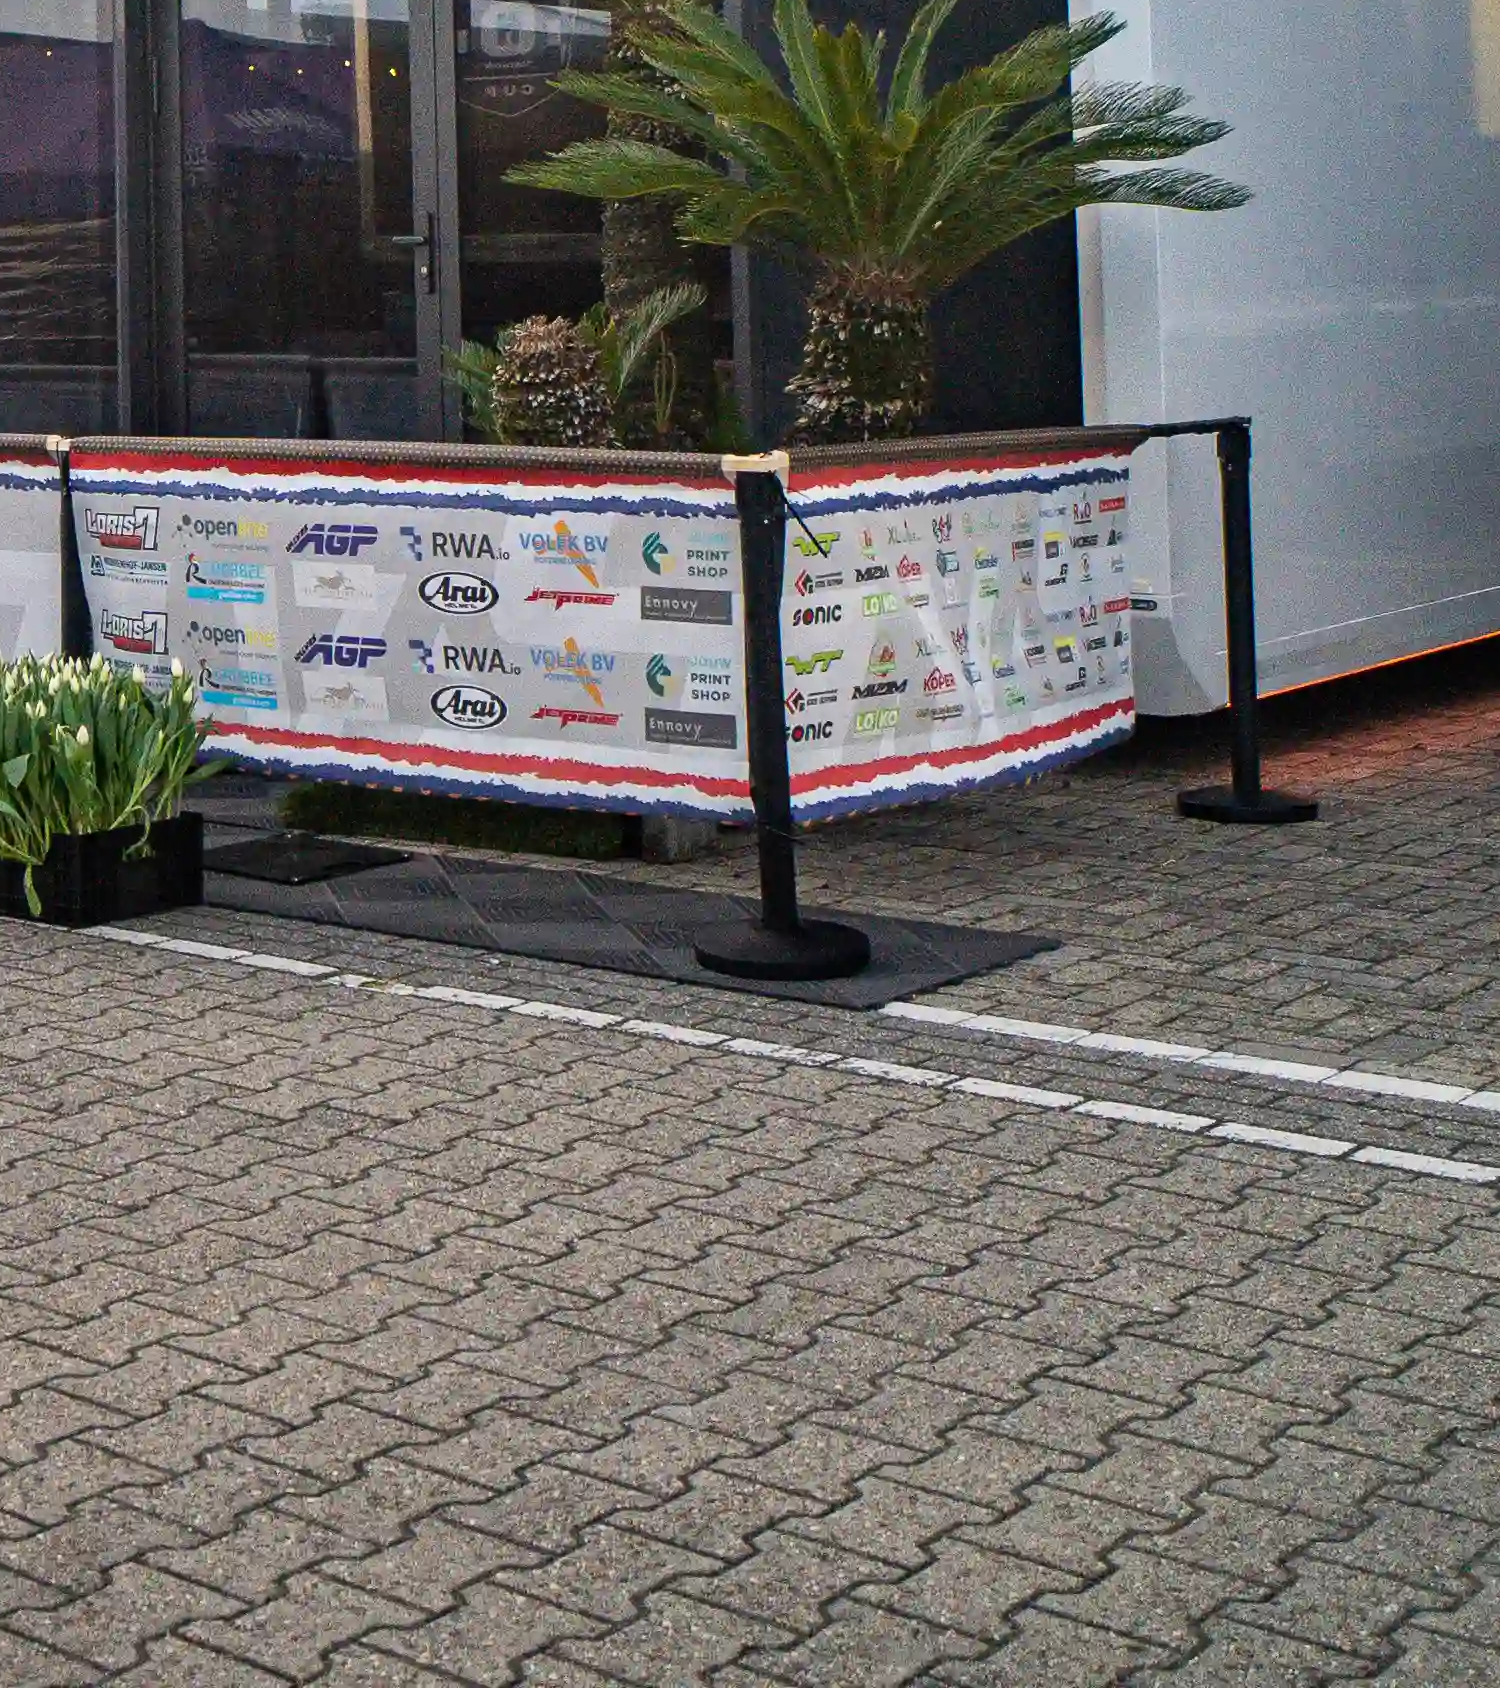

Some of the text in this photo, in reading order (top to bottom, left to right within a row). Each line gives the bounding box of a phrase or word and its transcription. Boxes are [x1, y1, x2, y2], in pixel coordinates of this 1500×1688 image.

[291, 522, 379, 557] AGP
[431, 531, 510, 561] RWA.io
[686, 549, 731, 562] PRINT
[686, 565, 728, 578] SHOP
[427, 576, 489, 604] Arai
[644, 595, 698, 618] Ennovy
[792, 603, 843, 627] SONIC
[202, 624, 276, 648] openline
[299, 633, 388, 669] AGP
[442, 644, 522, 676] RWA.io
[690, 672, 732, 686] PRINT
[436, 689, 498, 719] Arai
[690, 689, 731, 702] SHOP
[649, 716, 703, 741] Ennovy
